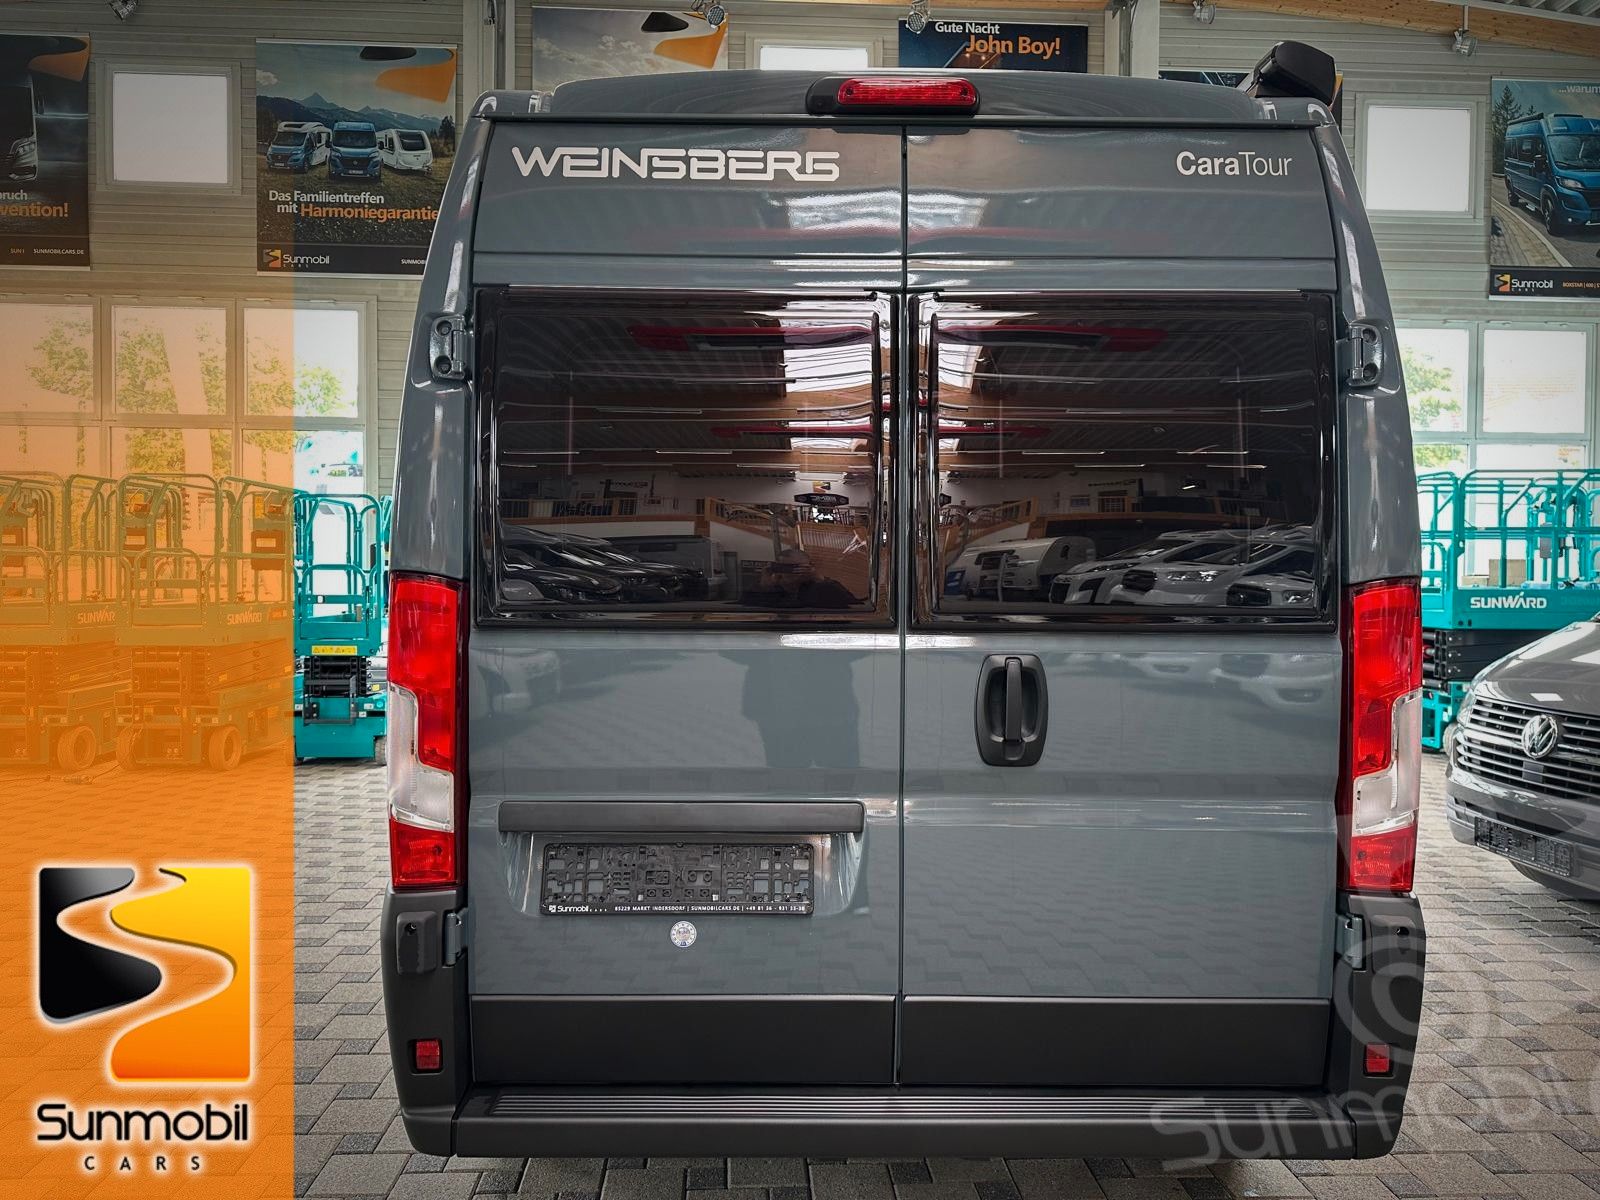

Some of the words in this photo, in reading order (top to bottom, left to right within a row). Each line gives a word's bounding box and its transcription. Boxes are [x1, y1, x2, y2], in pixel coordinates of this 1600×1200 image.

[935, 22, 963, 33] Gute
[966, 23, 1000, 34] Nacht
[966, 35, 1013, 54] John
[1018, 36, 1061, 60] Boy!
[511, 147, 841, 181] WEINSBERG
[1176, 151, 1292, 176] CaraTour
[269, 190, 291, 201] Das
[293, 191, 385, 204] Familientreffen
[277, 202, 298, 213] mit
[299, 203, 439, 223] Harmoniegarantie
[283, 254, 330, 265] Sunmobil
[1511, 279, 1554, 289] Sunmobil
[1470, 591, 1547, 609] SUNWARD
[227, 606, 262, 625] SUNWARD
